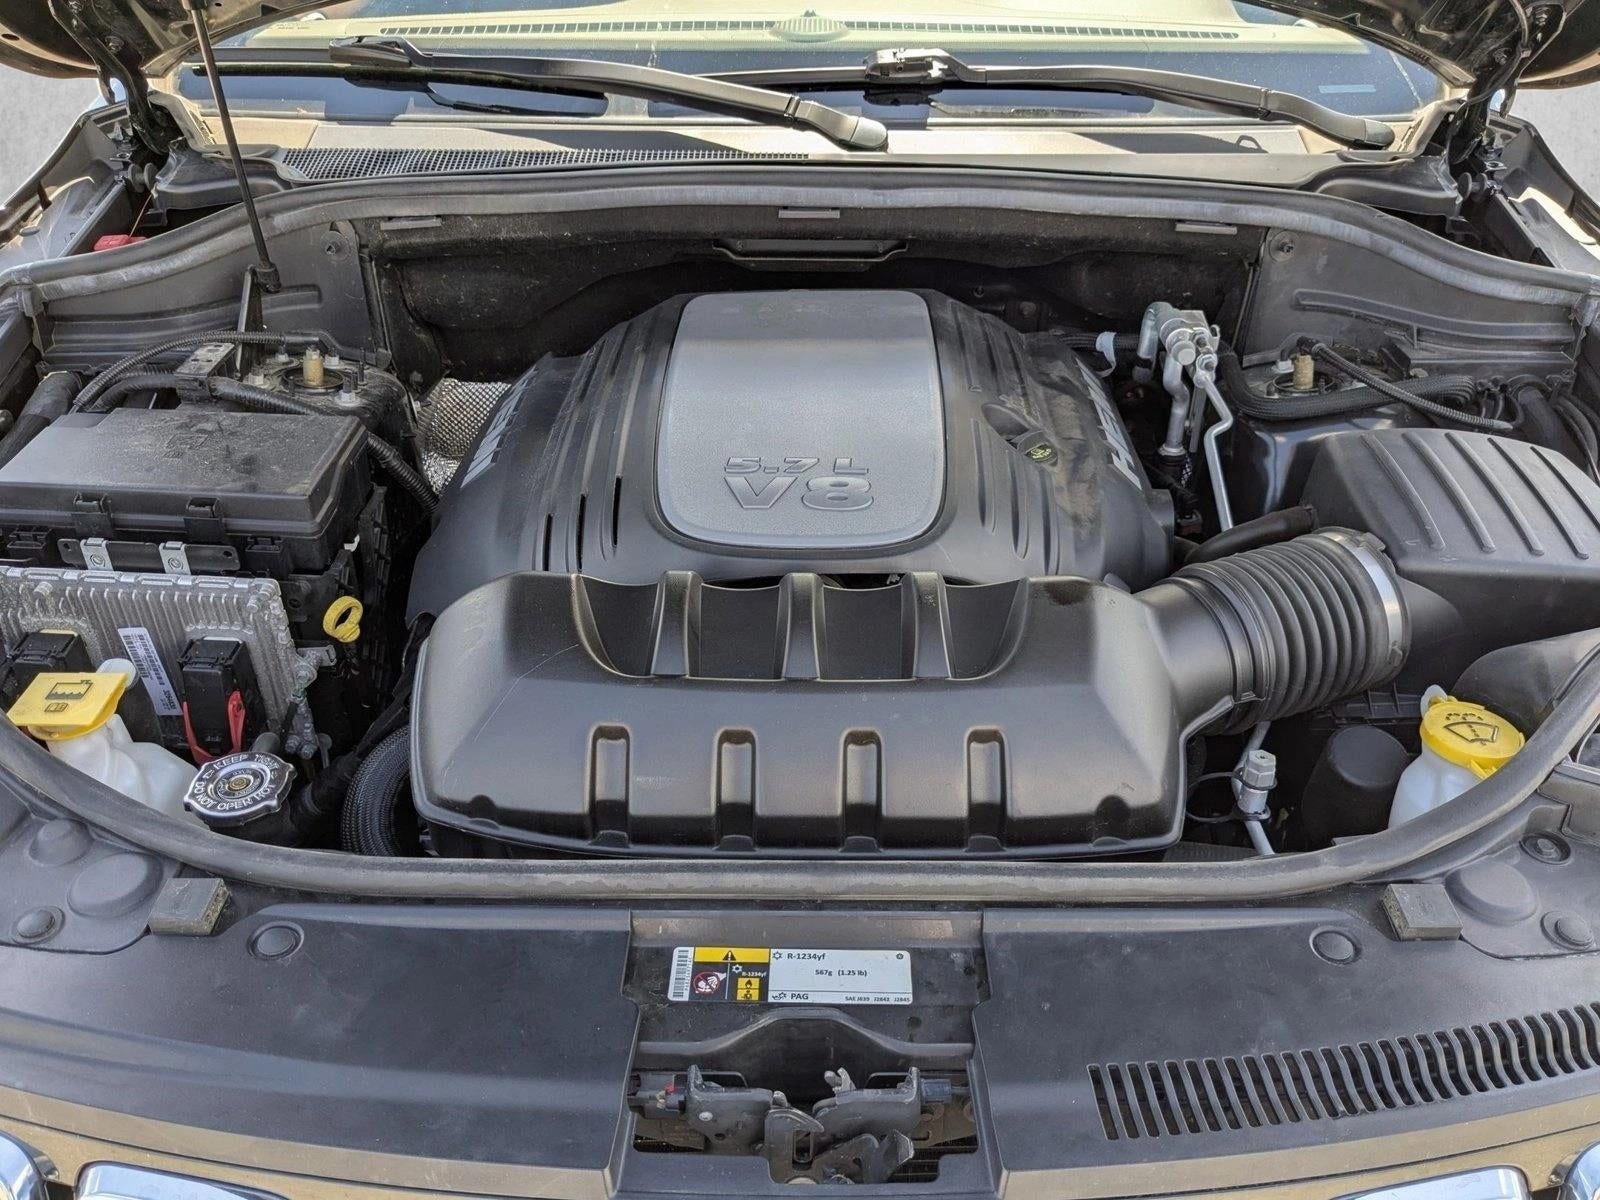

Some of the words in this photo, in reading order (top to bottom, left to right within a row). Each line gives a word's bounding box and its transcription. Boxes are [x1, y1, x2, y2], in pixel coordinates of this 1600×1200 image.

[724, 456, 820, 474] 5.7
[832, 456, 869, 475] L
[723, 476, 875, 511] V8
[213, 753, 249, 769] KEEP
[196, 793, 218, 808] NOT
[217, 798, 254, 811] OPEN
[787, 952, 826, 961] R-1234yf
[815, 969, 833, 977] 567g
[837, 969, 856, 977] (1.25
[857, 969, 868, 977] lb)
